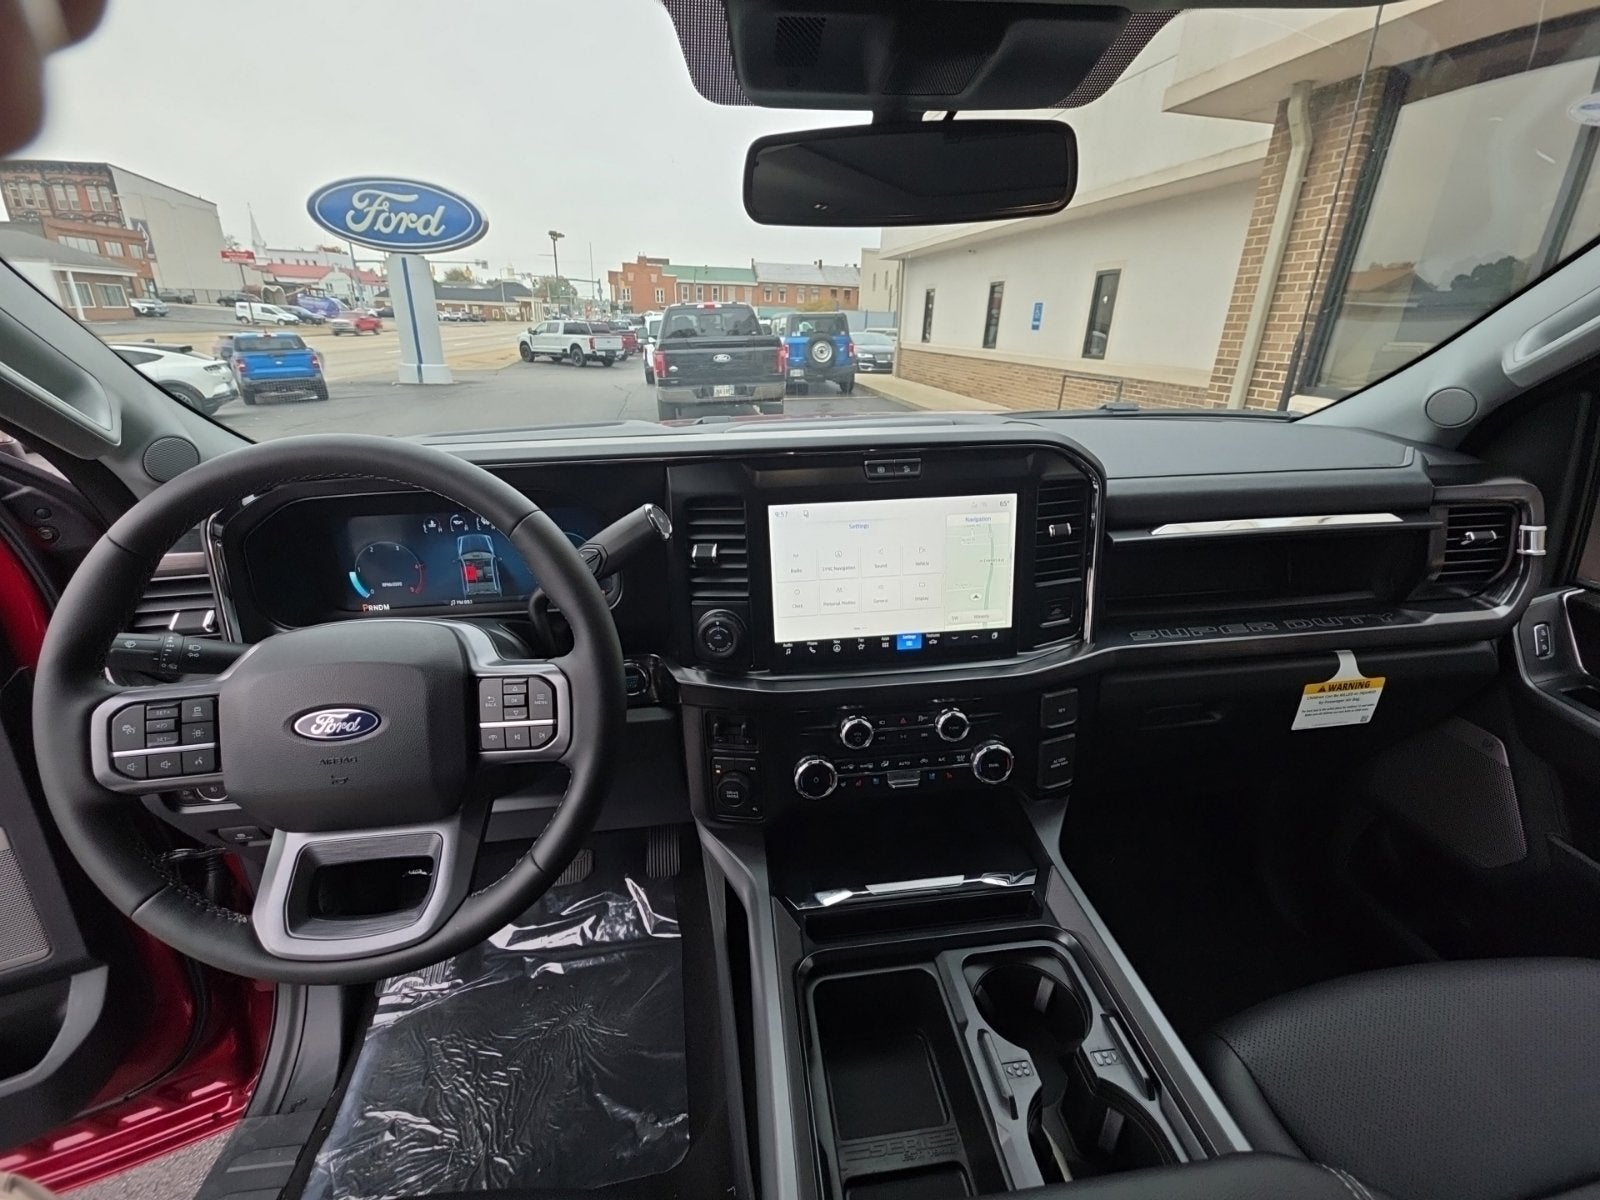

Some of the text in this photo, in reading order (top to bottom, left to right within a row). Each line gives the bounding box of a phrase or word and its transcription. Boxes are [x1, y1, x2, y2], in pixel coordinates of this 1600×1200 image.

[345, 189, 446, 237] Ford
[1129, 613, 1393, 641] SUPER DUTY
[1328, 681, 1371, 693] WARNING
[310, 714, 361, 735] Ford
